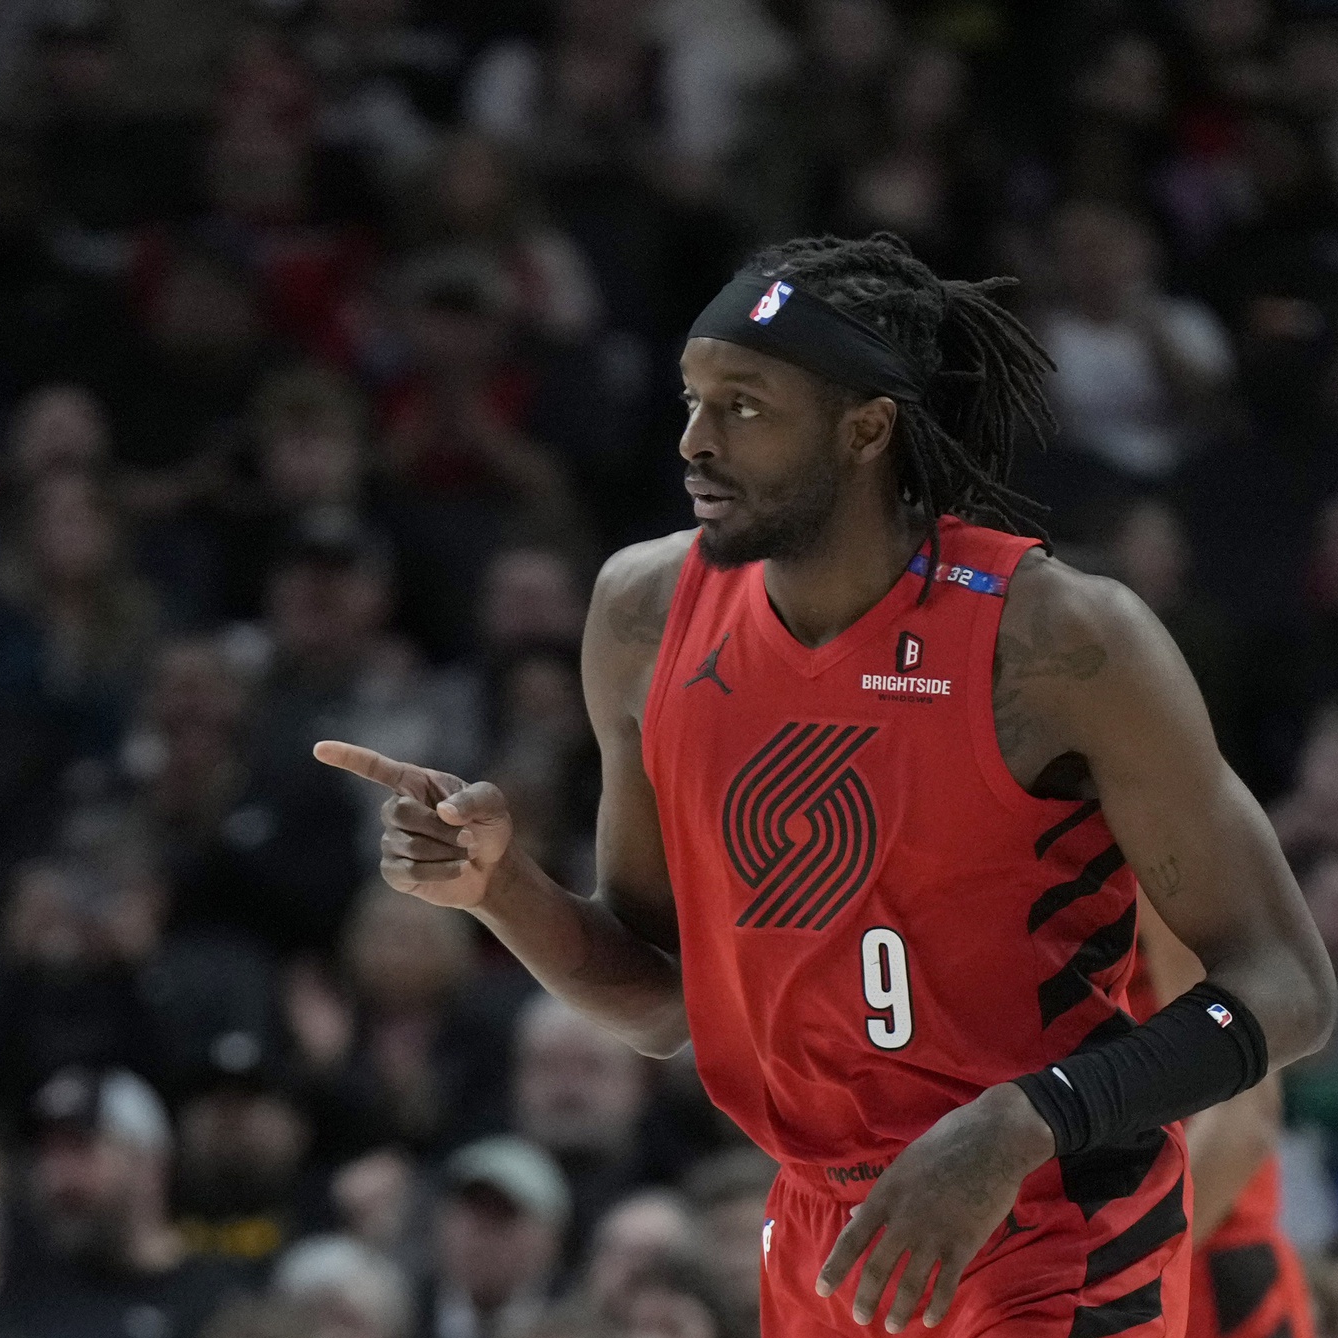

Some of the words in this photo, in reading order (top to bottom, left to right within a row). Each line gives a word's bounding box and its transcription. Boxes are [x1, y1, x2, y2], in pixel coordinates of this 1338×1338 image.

[947, 567, 974, 586] 32
[905, 639, 919, 666] B
[862, 674, 951, 695] BRIGHTSIDE
[878, 693, 933, 704] WINDOWS
[861, 926, 914, 1051] 9
